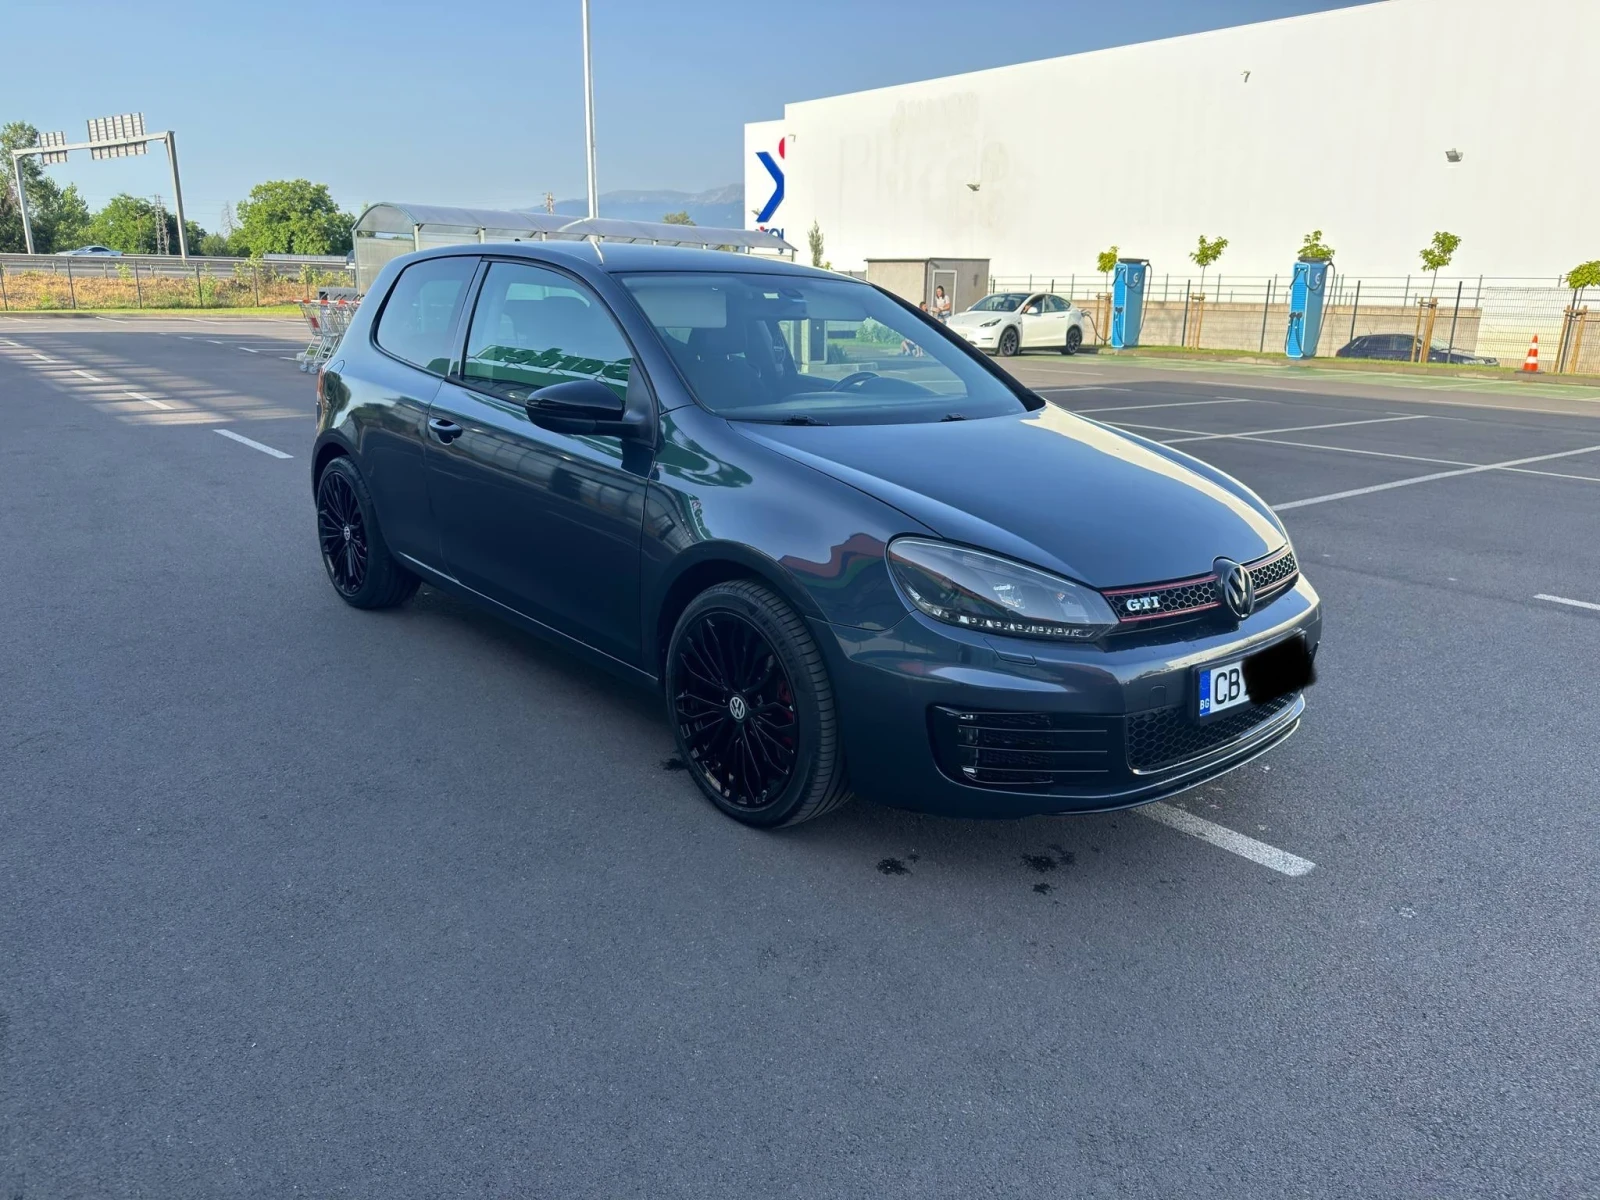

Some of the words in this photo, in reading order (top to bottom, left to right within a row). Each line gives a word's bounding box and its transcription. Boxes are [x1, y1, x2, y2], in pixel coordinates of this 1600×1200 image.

[1126, 595, 1160, 611] GTI
[1214, 667, 1240, 705] CB
[730, 696, 745, 719] VW
[1199, 698, 1210, 710] BG
